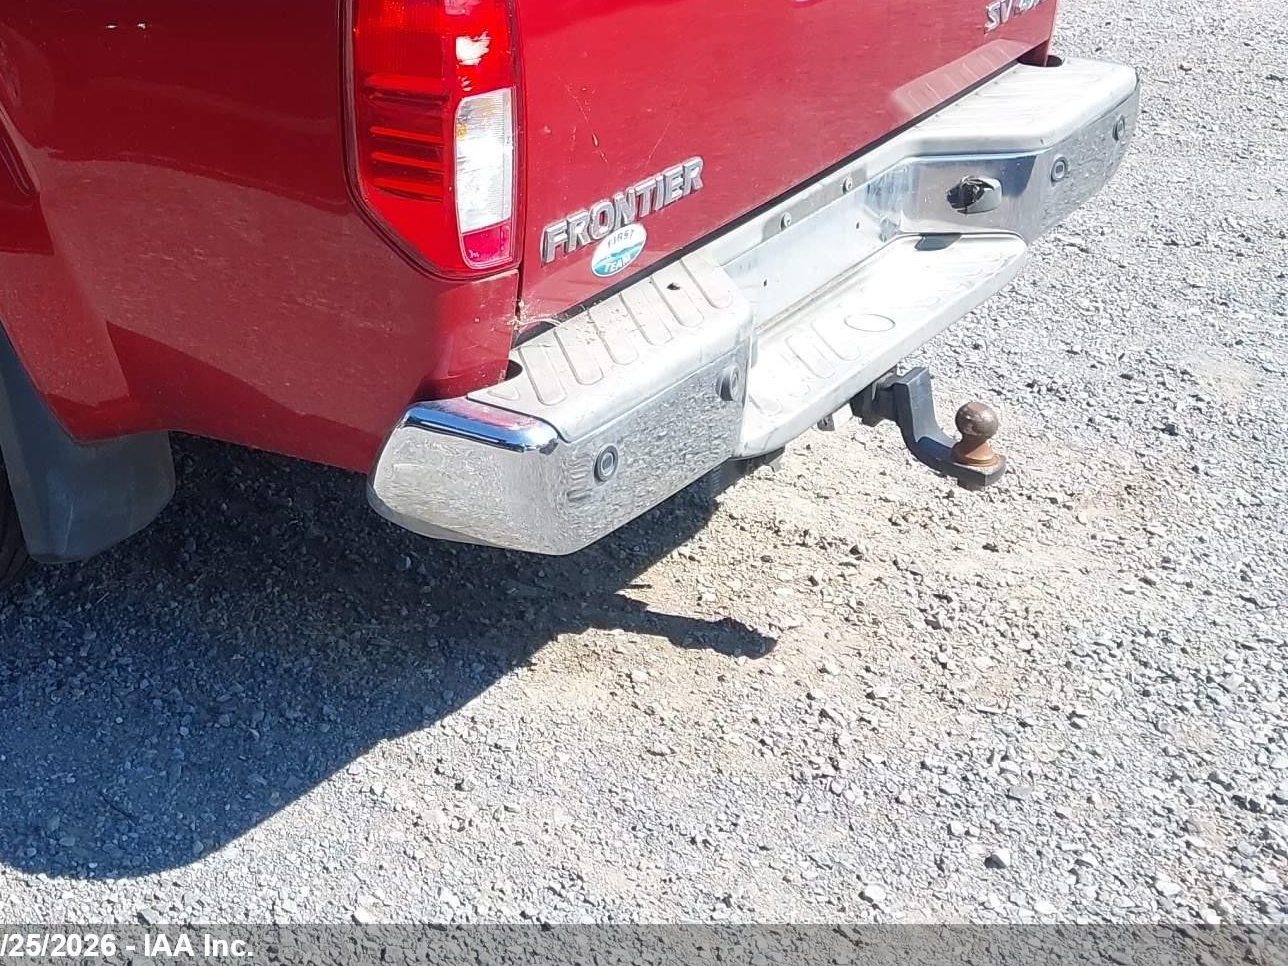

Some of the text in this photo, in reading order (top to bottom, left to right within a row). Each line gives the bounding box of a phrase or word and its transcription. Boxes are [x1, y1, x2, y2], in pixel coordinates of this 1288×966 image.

[541, 156, 704, 266] FRONTIER
[607, 229, 635, 249] FIRST
[604, 253, 632, 274] TEAM
